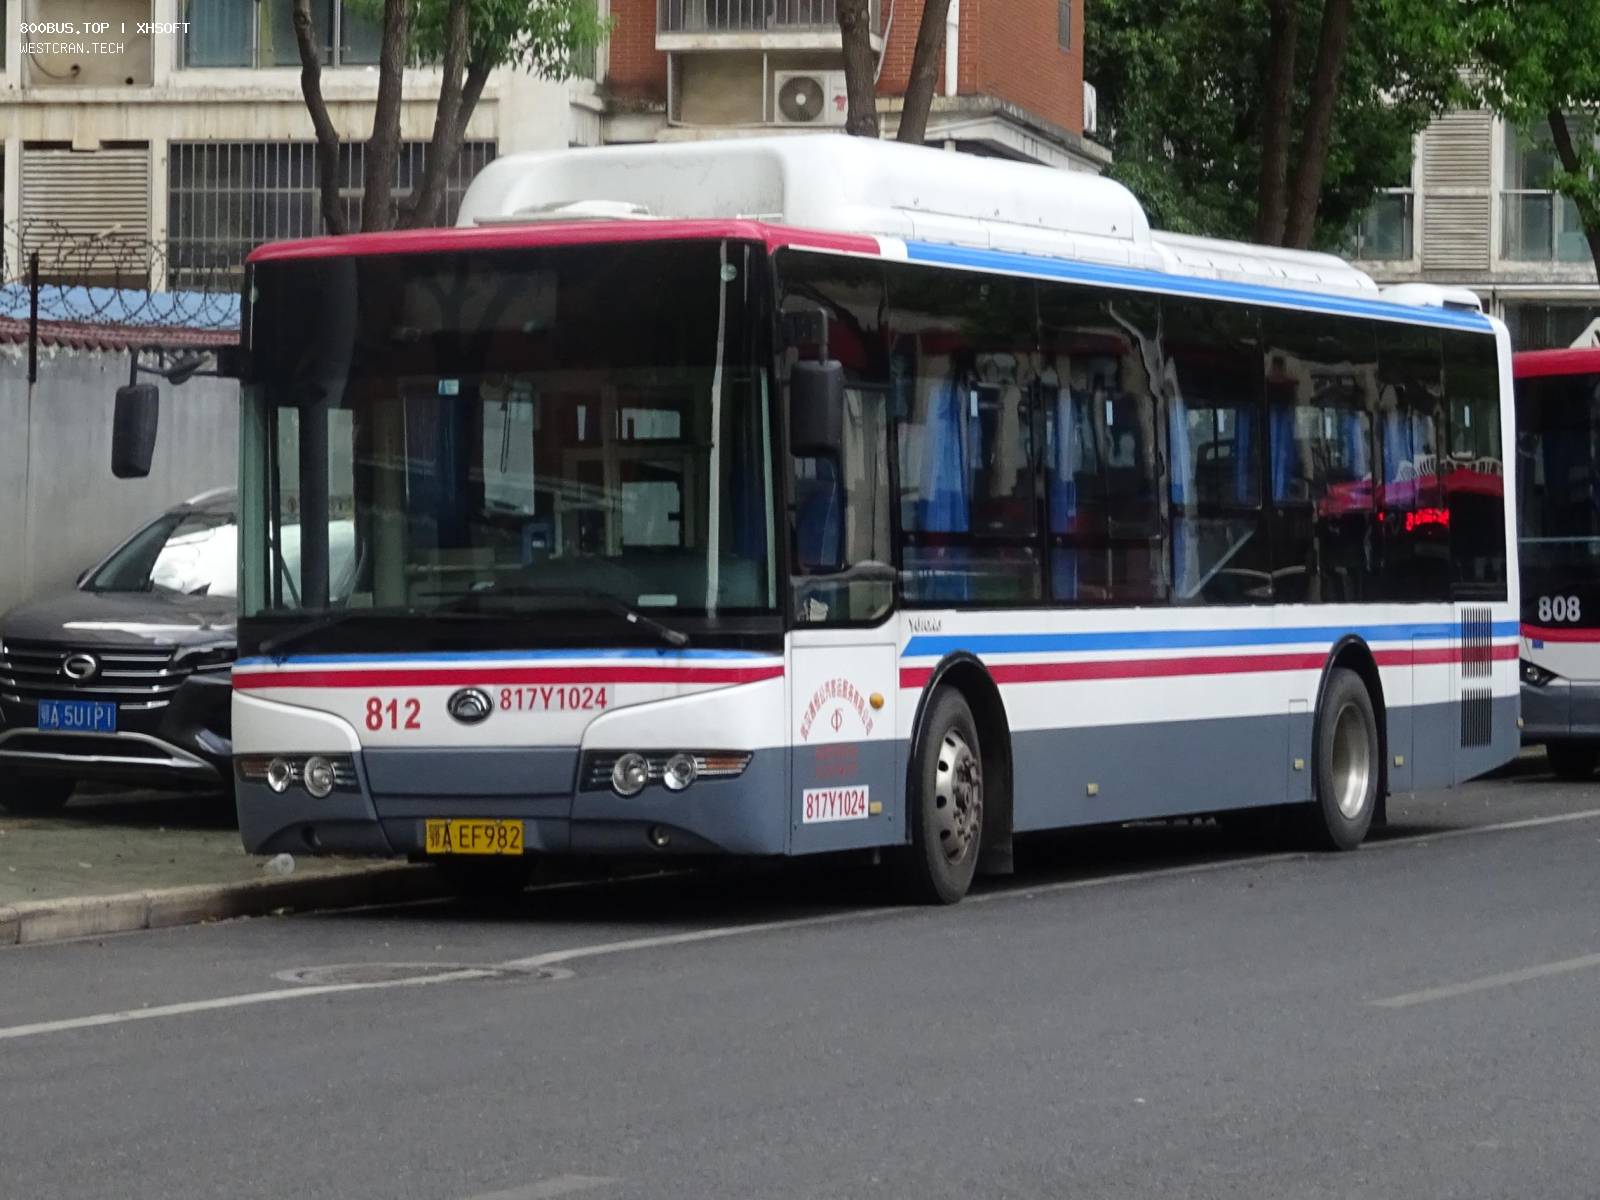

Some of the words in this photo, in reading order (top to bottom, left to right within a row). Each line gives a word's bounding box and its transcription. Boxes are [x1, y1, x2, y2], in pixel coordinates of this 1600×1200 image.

[1538, 595, 1581, 622] 808
[500, 686, 607, 711] 817Y1024
[365, 696, 421, 731] 812
[806, 790, 865, 819] 817Y1024
